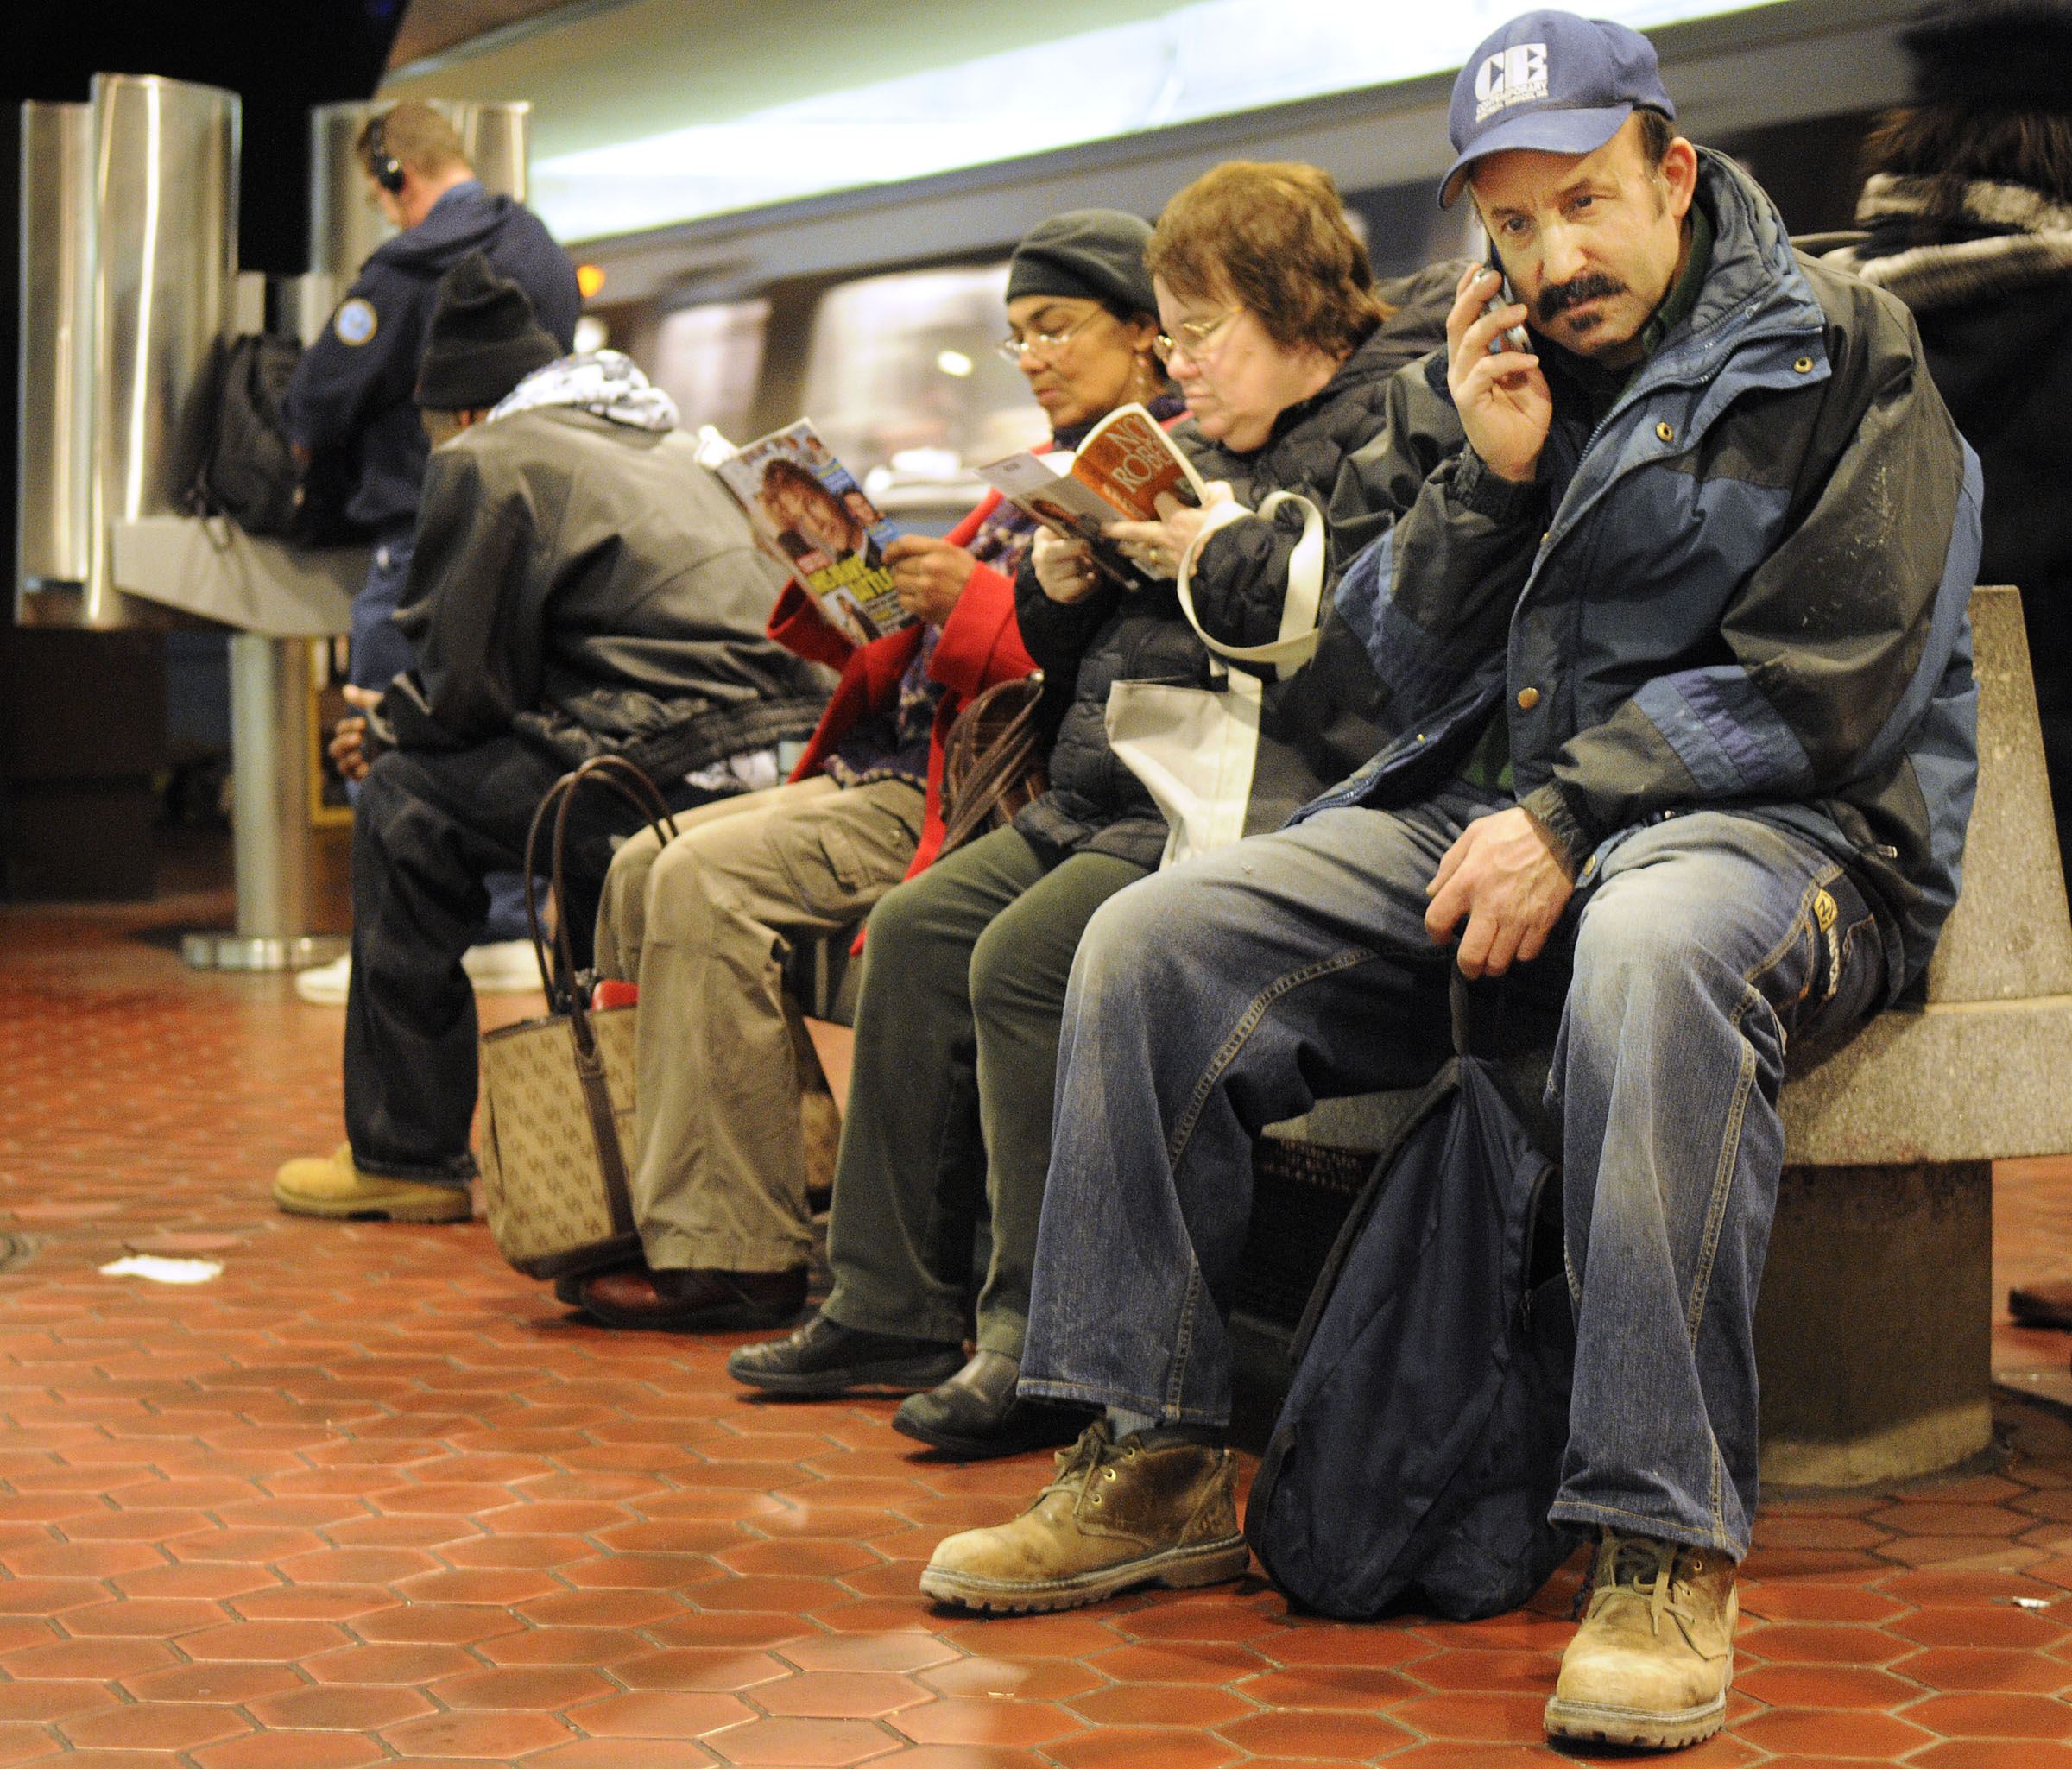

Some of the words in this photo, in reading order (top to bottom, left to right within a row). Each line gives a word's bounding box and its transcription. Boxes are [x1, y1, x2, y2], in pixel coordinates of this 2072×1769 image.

[1475, 43, 1548, 102] CE
[1106, 415, 1151, 456] NO
[1112, 439, 1173, 493] ROBE
